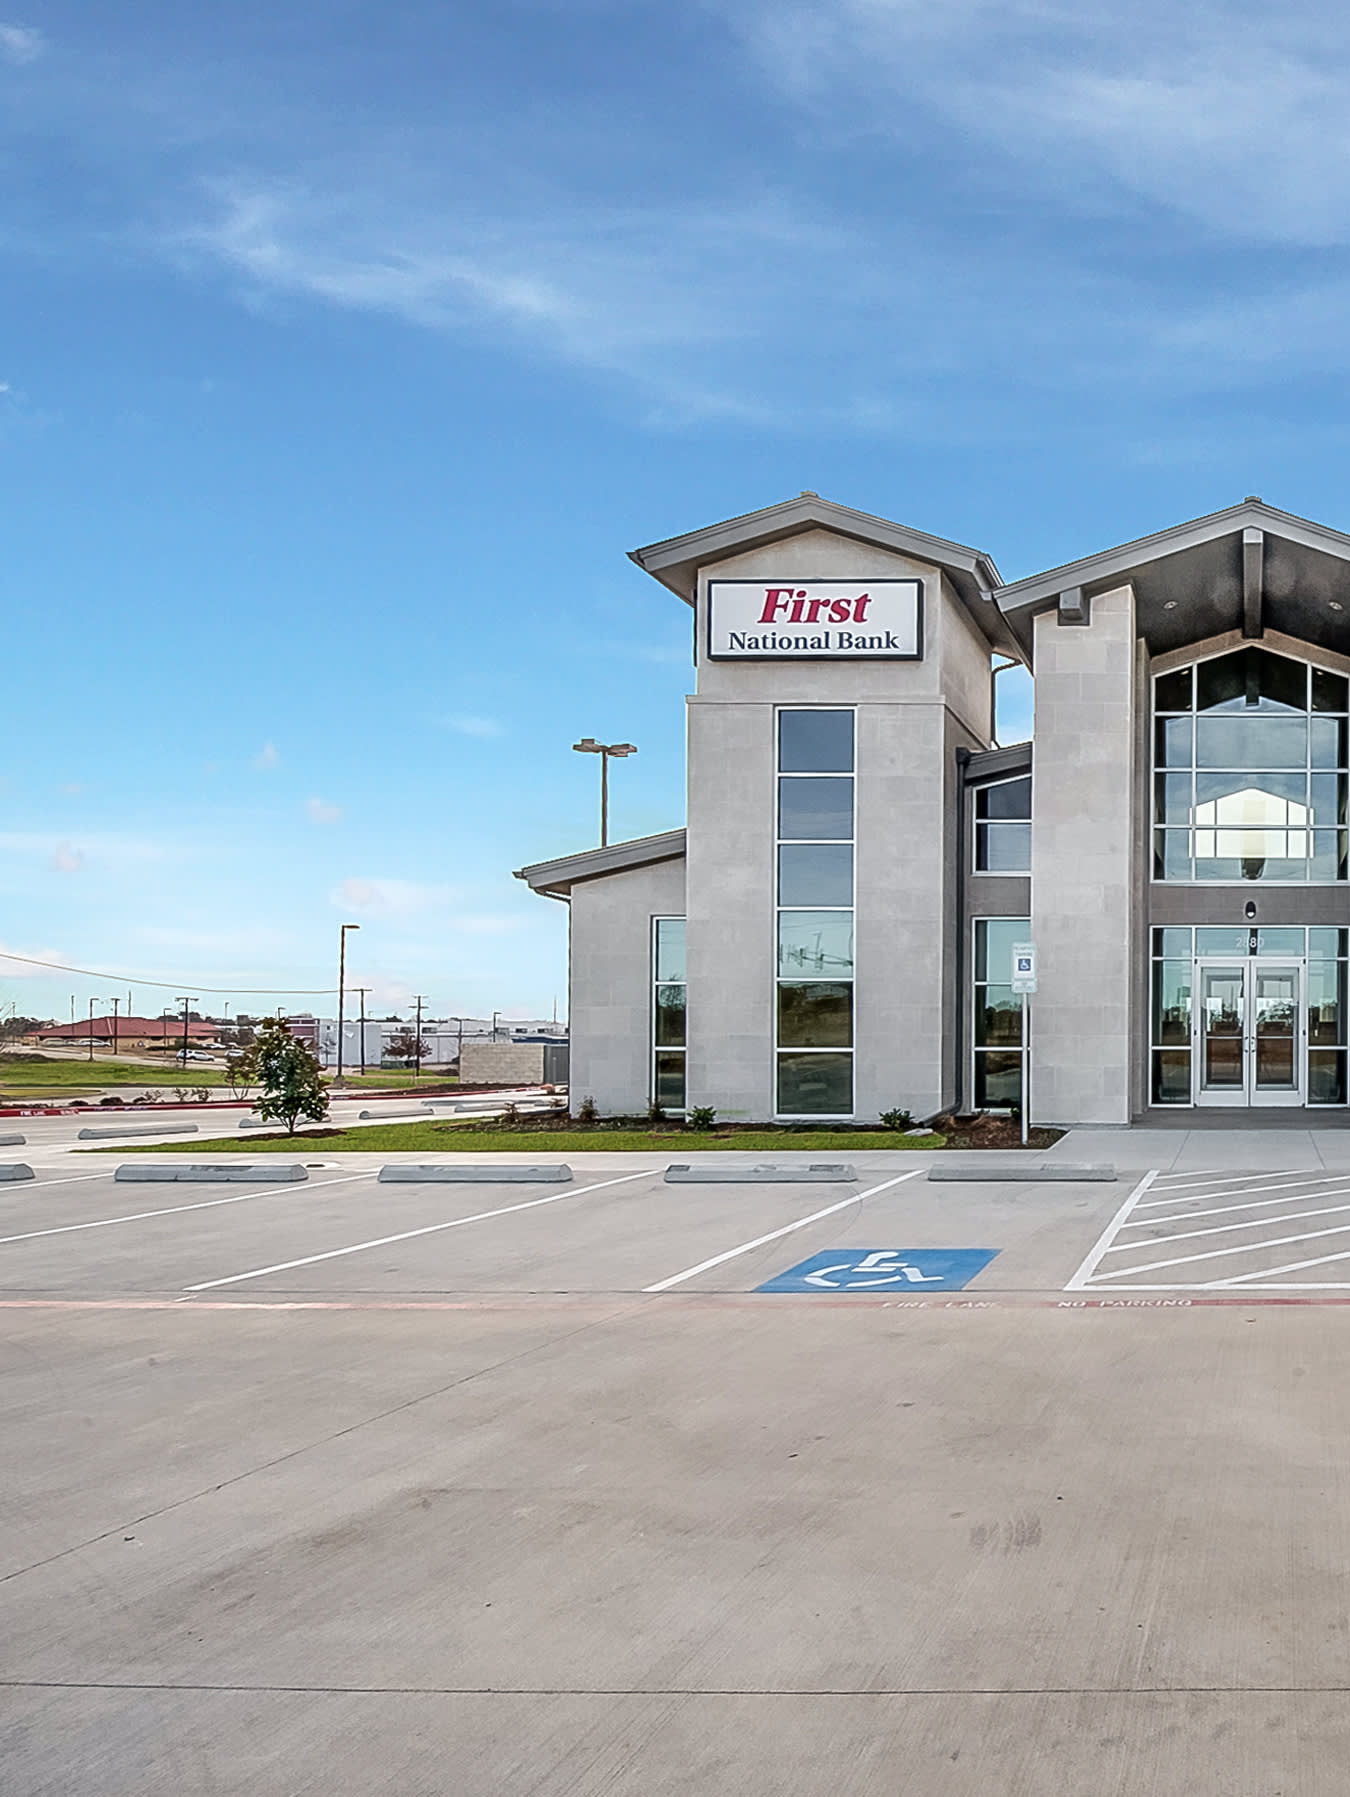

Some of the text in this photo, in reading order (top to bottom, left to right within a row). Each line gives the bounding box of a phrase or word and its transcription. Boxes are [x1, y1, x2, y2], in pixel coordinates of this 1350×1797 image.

[757, 588, 872, 624] First
[728, 631, 900, 650] National Bank
[1057, 1300, 1087, 1308] NO
[1099, 1299, 1193, 1307] PARKING
